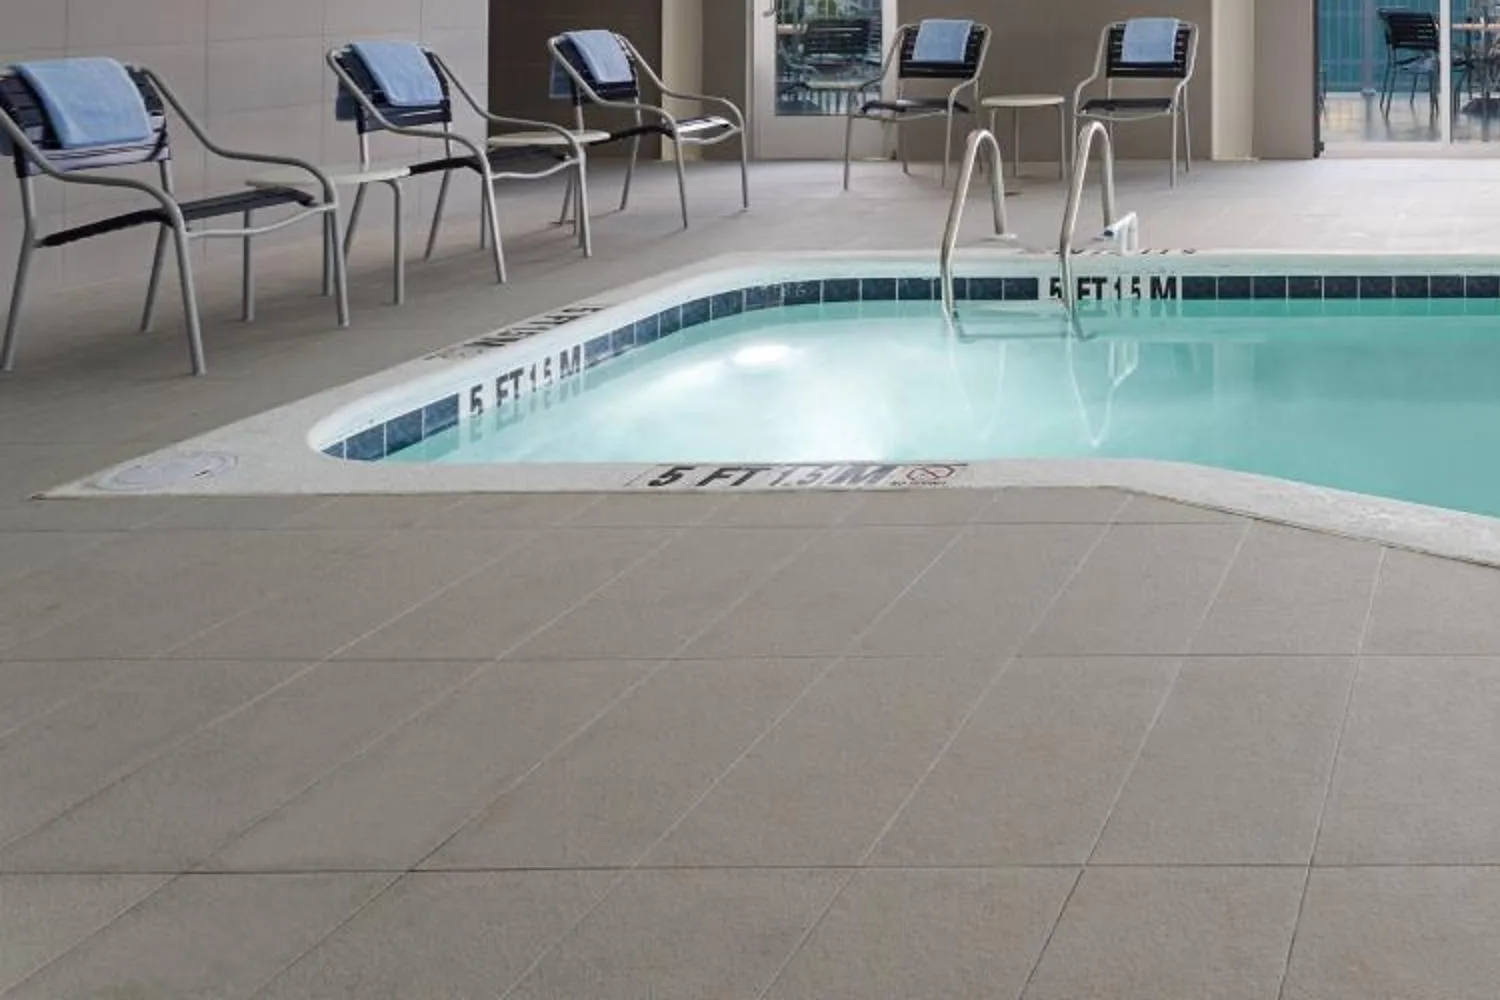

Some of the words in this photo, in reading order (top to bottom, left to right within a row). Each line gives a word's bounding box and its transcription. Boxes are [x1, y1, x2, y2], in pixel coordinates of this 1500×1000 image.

[1077, 276, 1107, 300] FT
[1151, 276, 1177, 300] M
[470, 384, 484, 416] 5
[496, 367, 525, 408] FT
[559, 344, 582, 380] M
[648, 466, 696, 487] 5
[696, 467, 772, 487] FT
[830, 463, 899, 486] M
